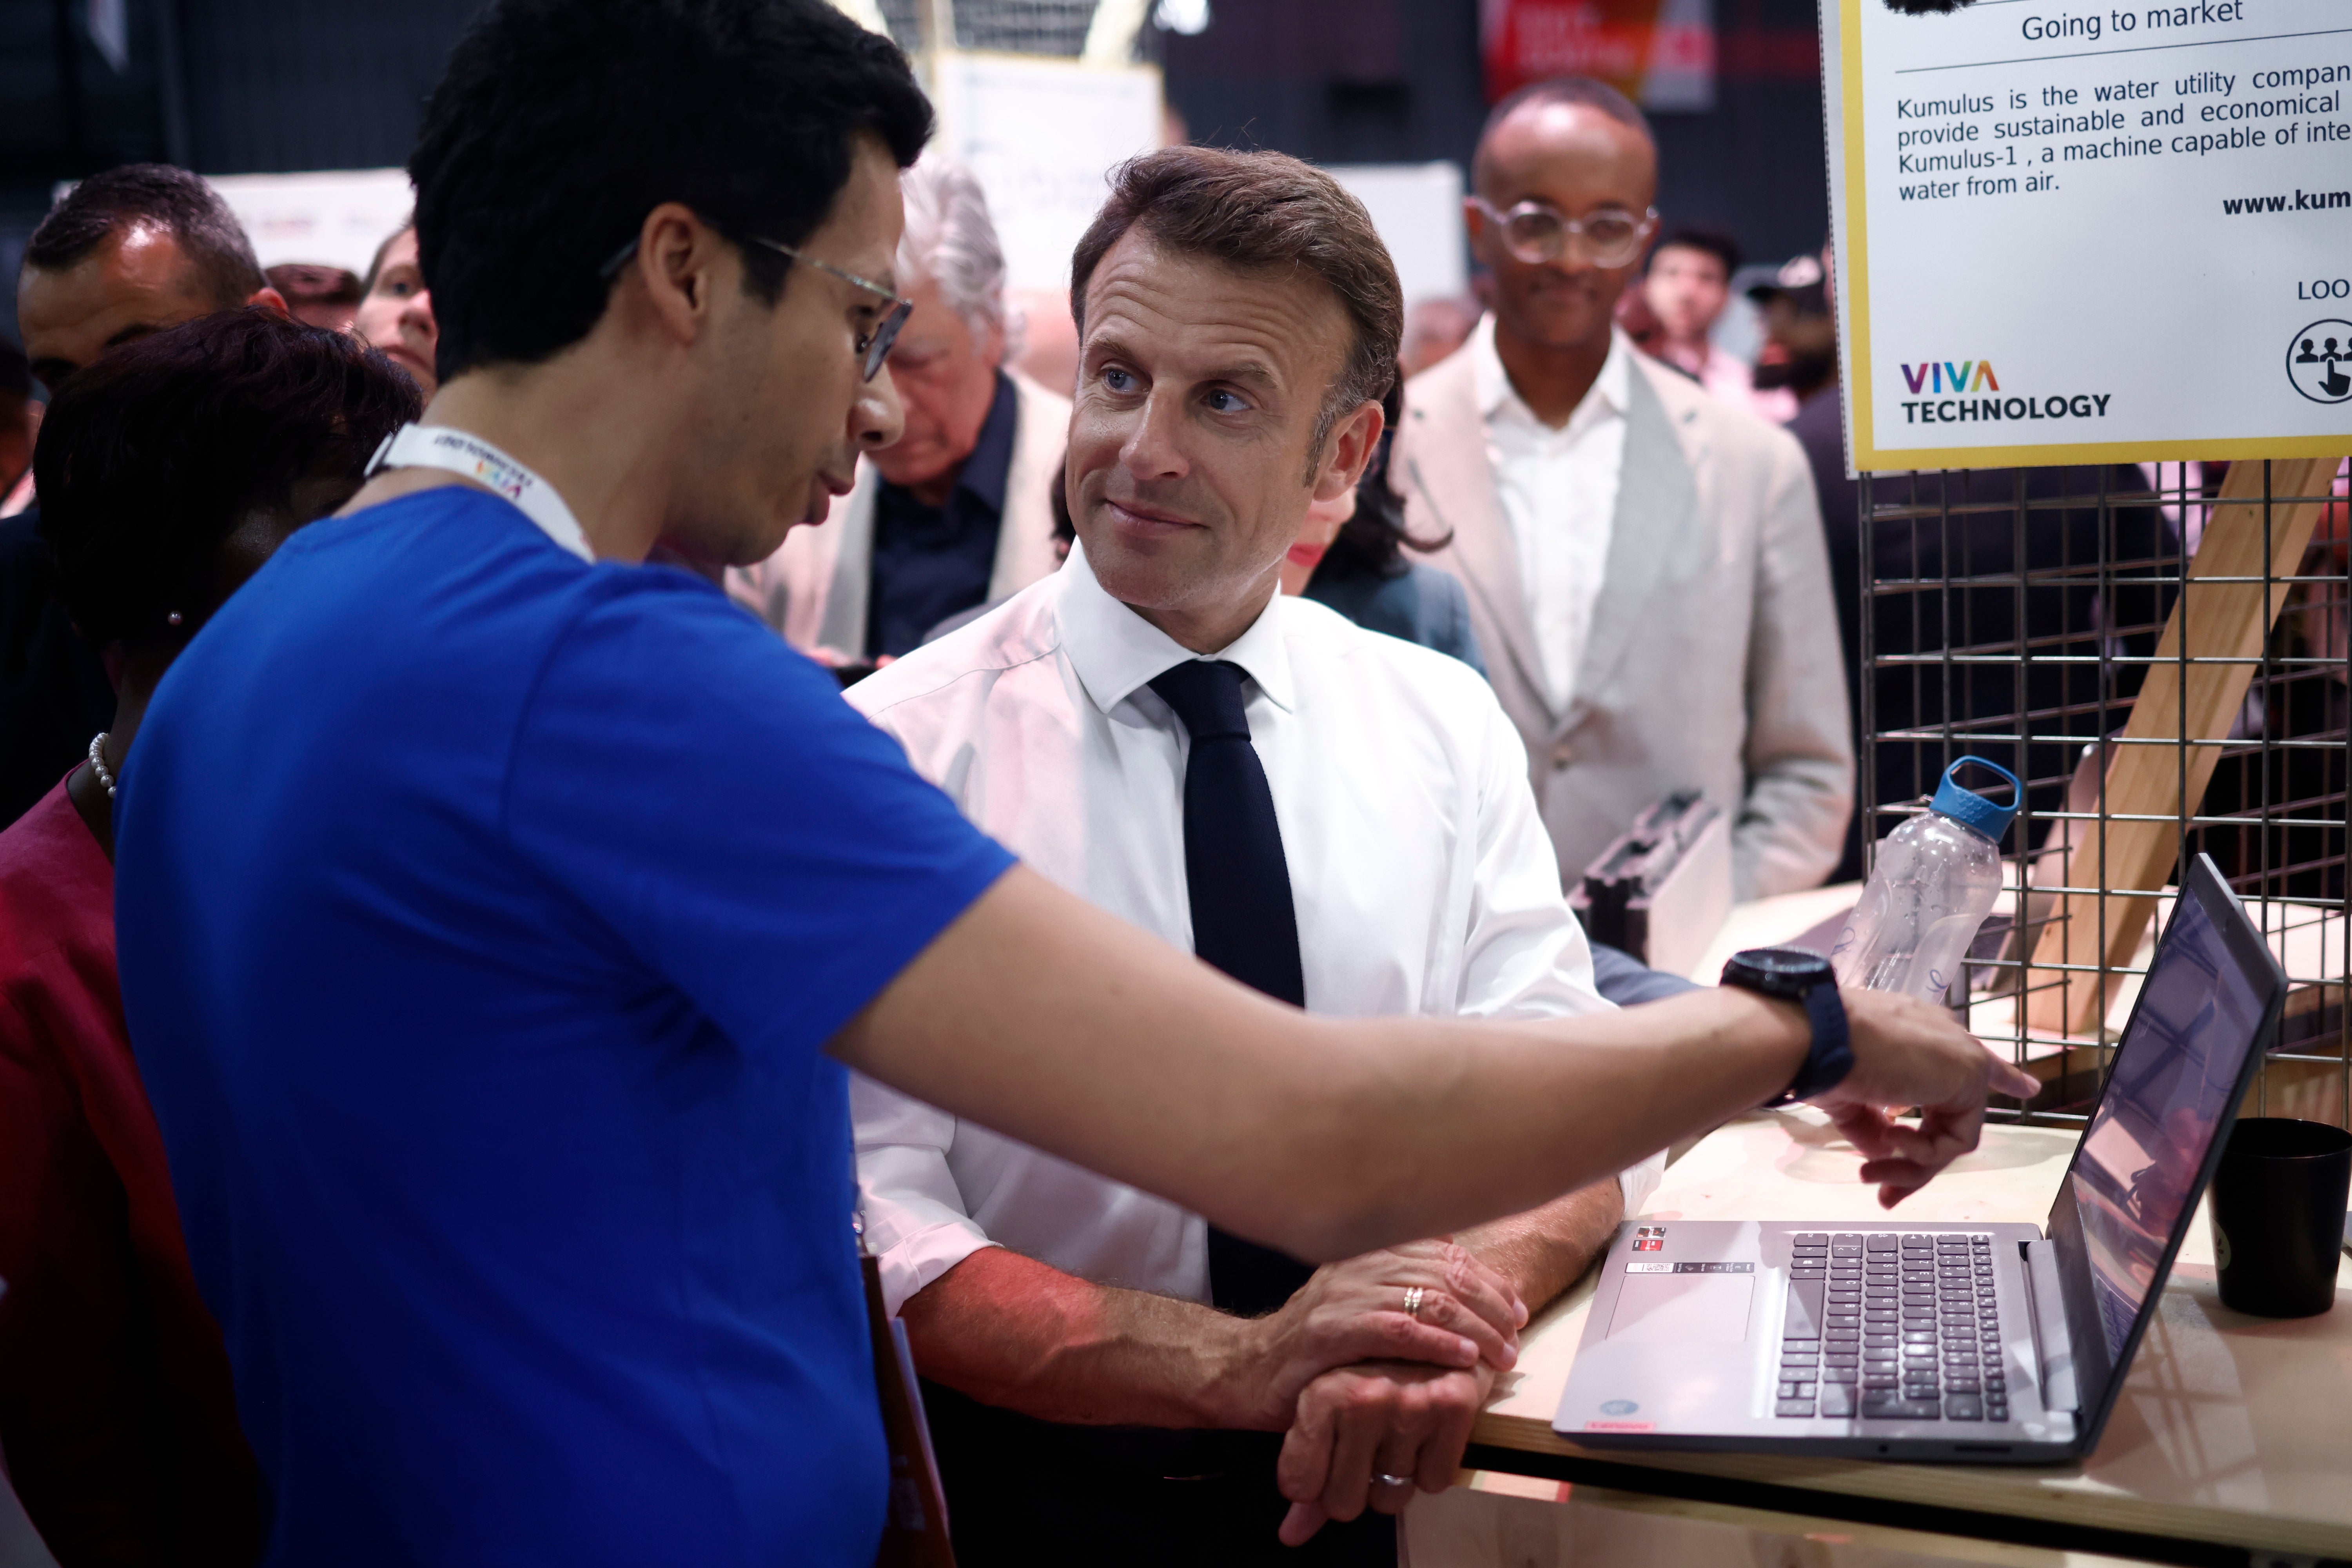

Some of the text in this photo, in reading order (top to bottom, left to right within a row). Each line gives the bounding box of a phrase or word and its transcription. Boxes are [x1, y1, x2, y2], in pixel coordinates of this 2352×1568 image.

[2022, 0, 2243, 41] Going to market
[1897, 93, 1994, 120] Kumulus
[2009, 89, 2027, 110] is
[2042, 85, 2078, 107] the
[2094, 80, 2160, 102] water
[2175, 71, 2236, 97] utility
[1898, 89, 2339, 152] provide sustainable and economical
[1899, 145, 2017, 174] Kumulus-1
[2041, 147, 2054, 163] a
[2063, 135, 2163, 162] machine
[2171, 125, 2266, 157] capable
[2275, 122, 2299, 145] of
[2307, 120, 2351, 143] inte
[1898, 170, 2060, 201] water from air.
[2222, 189, 2351, 216] www.kum
[2298, 278, 2350, 301] LOO
[1900, 360, 2000, 394] VIVA
[1900, 393, 2112, 424] TECHNOLOGY
